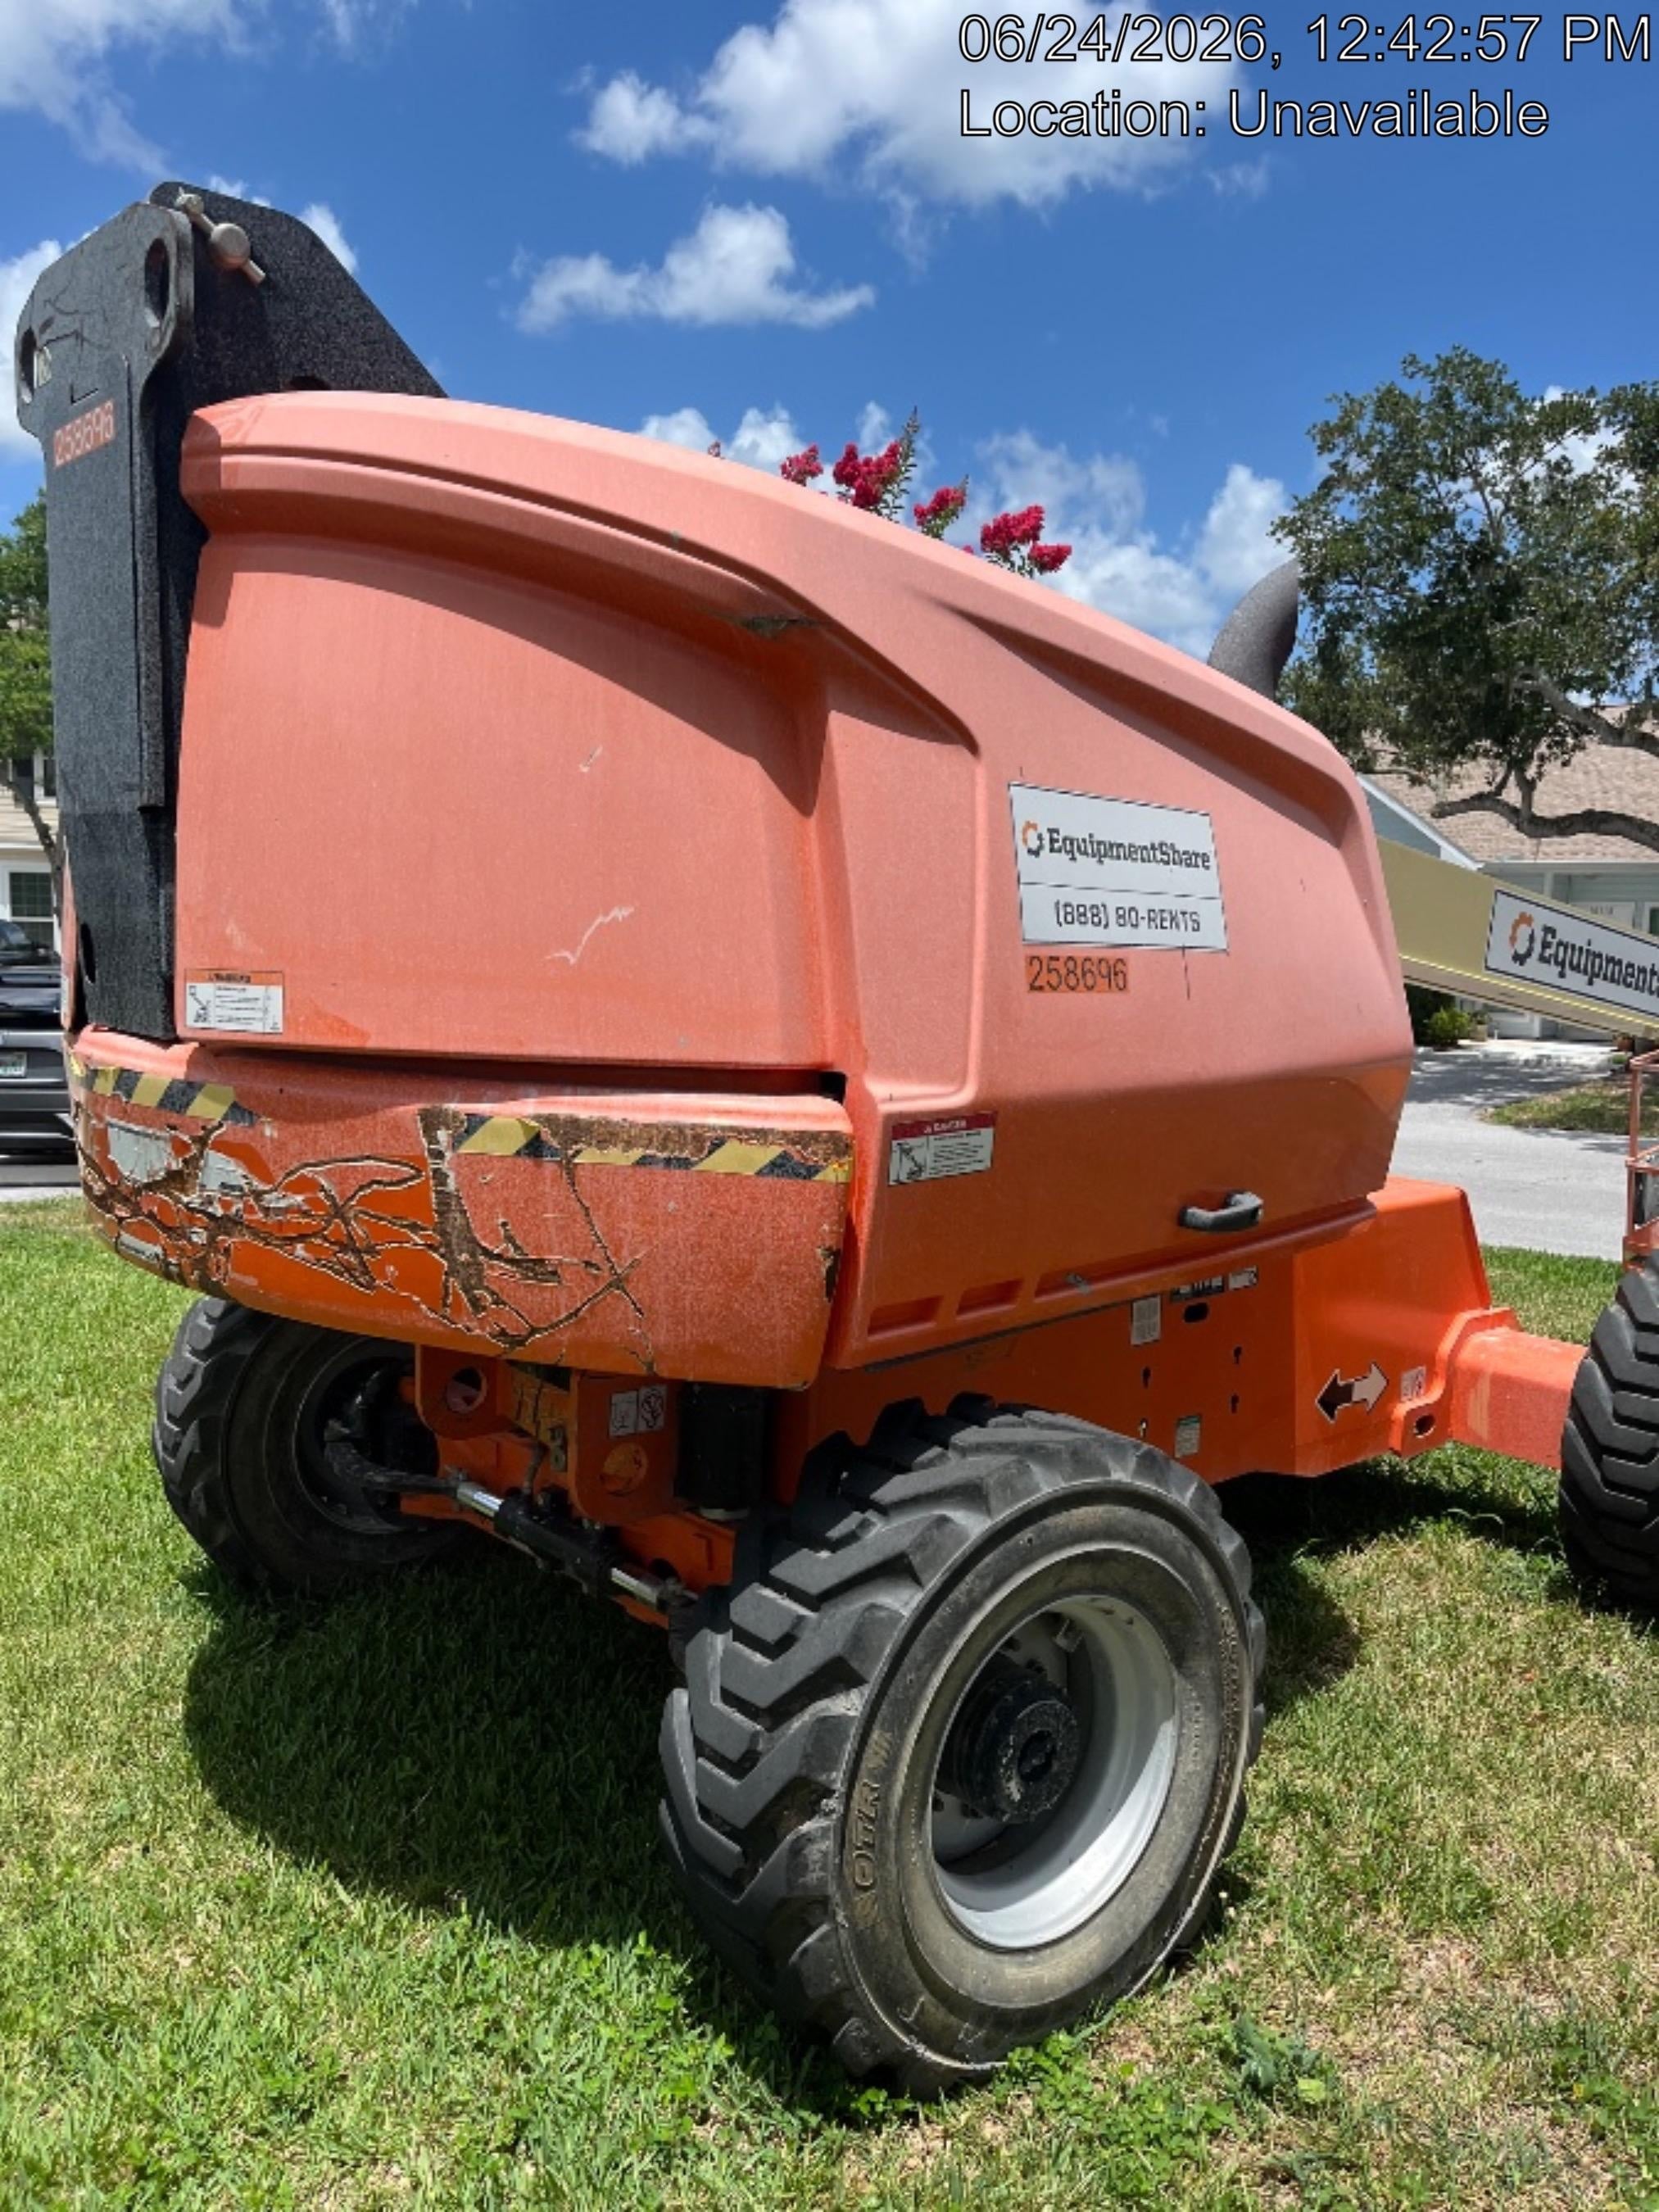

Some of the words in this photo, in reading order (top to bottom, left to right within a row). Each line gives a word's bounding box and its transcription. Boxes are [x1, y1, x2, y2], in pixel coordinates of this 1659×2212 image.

[1046, 827, 1212, 871] EquipmentShare
[1054, 900, 1110, 930] (888)
[1115, 906, 1202, 932] 80-RENTS
[1028, 955, 1127, 992] 258696
[1538, 924, 1659, 998] Equipment
